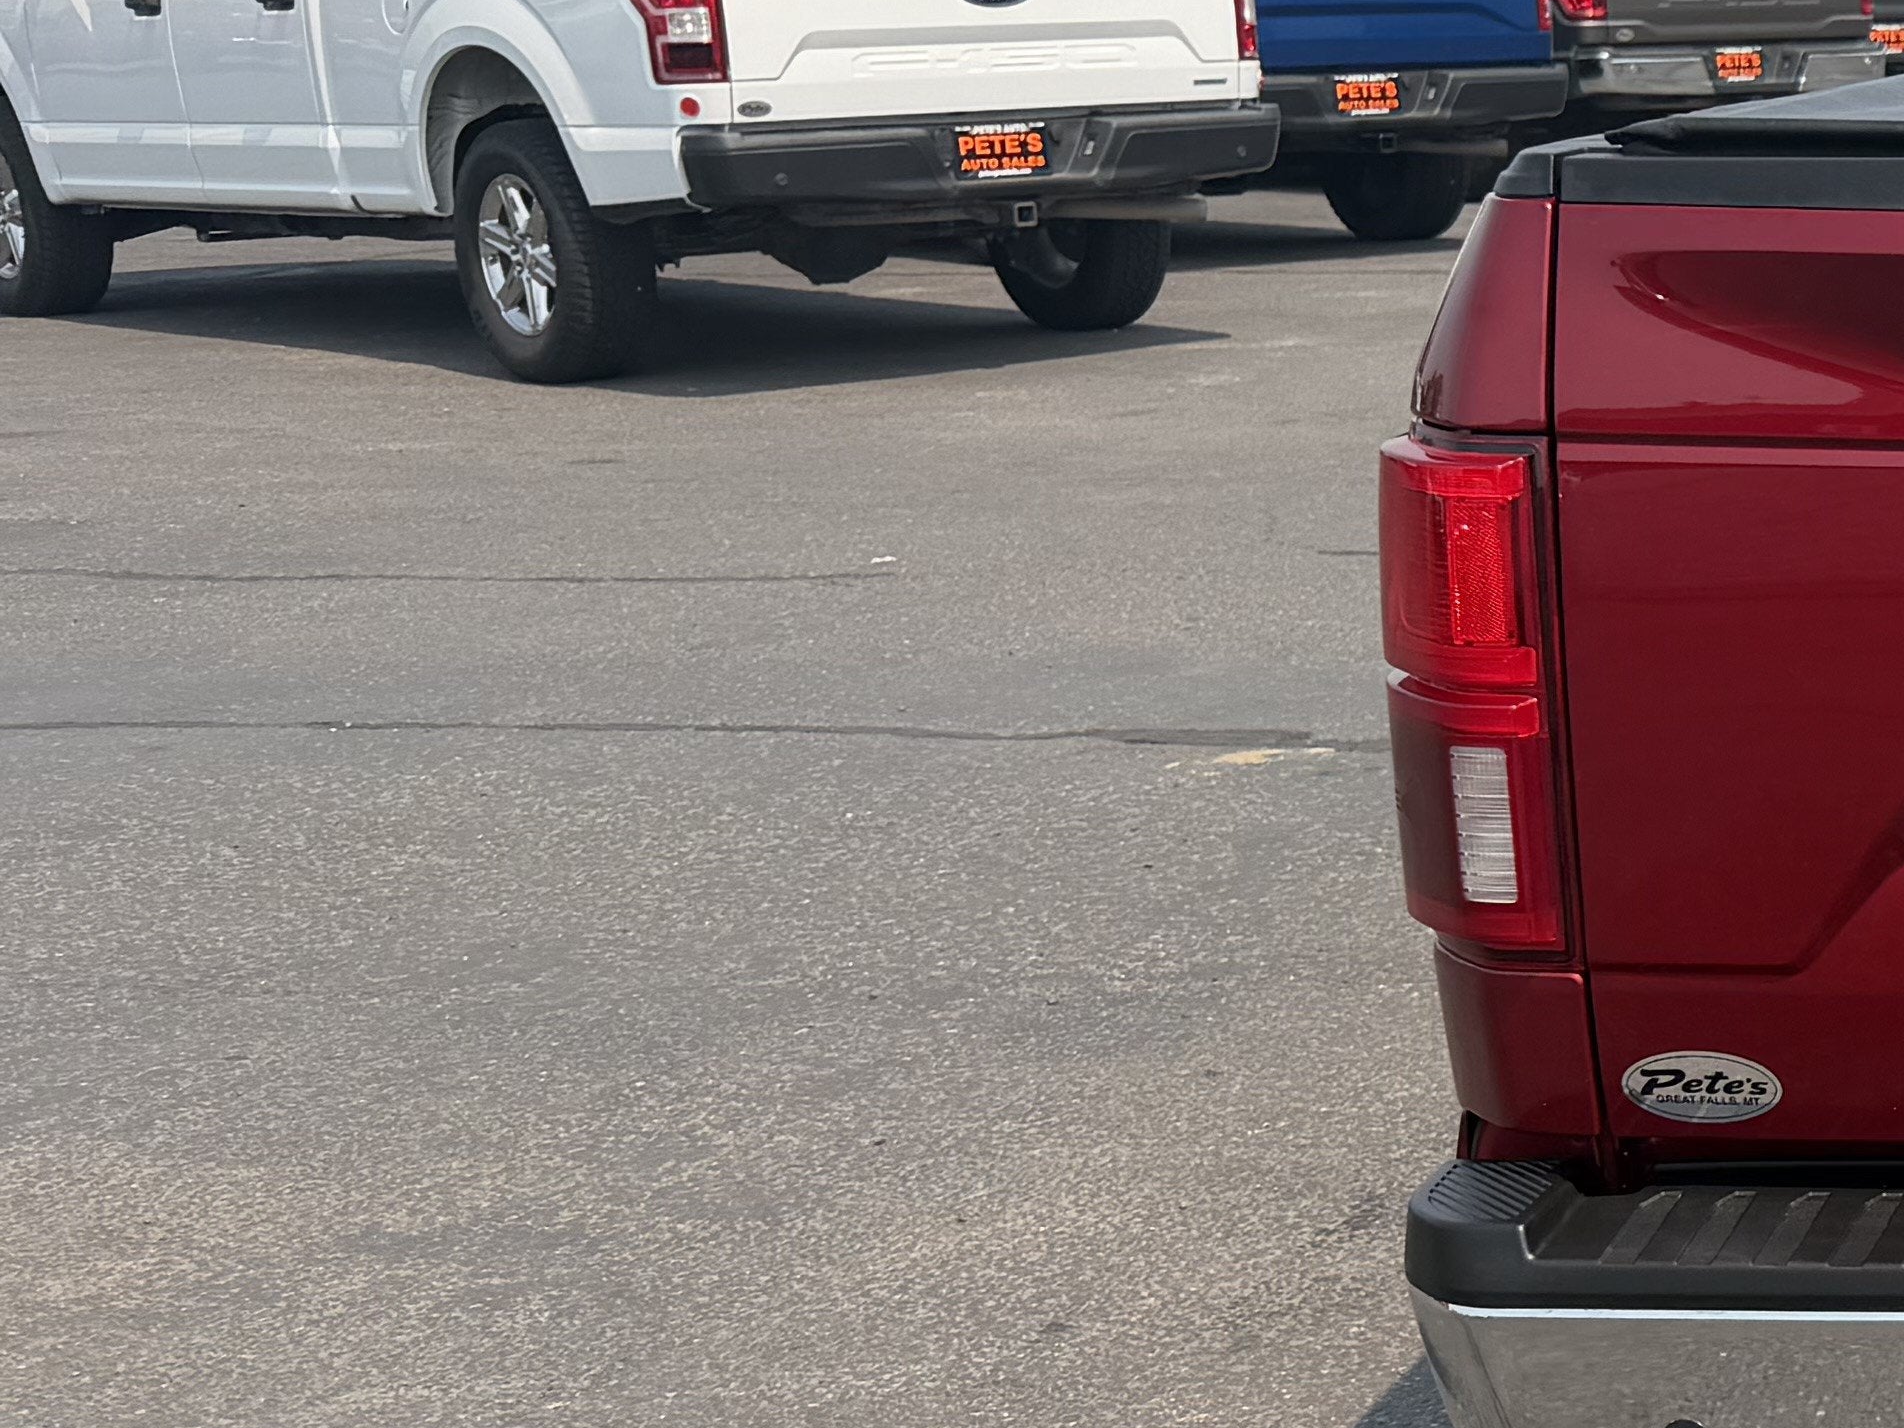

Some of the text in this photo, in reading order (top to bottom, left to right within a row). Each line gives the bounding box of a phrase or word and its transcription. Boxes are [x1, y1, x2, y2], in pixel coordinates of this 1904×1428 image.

[958, 133, 1043, 156] PETE'S
[961, 155, 1046, 171] AUTO SALES
[1640, 1068, 1769, 1095] Pete's
